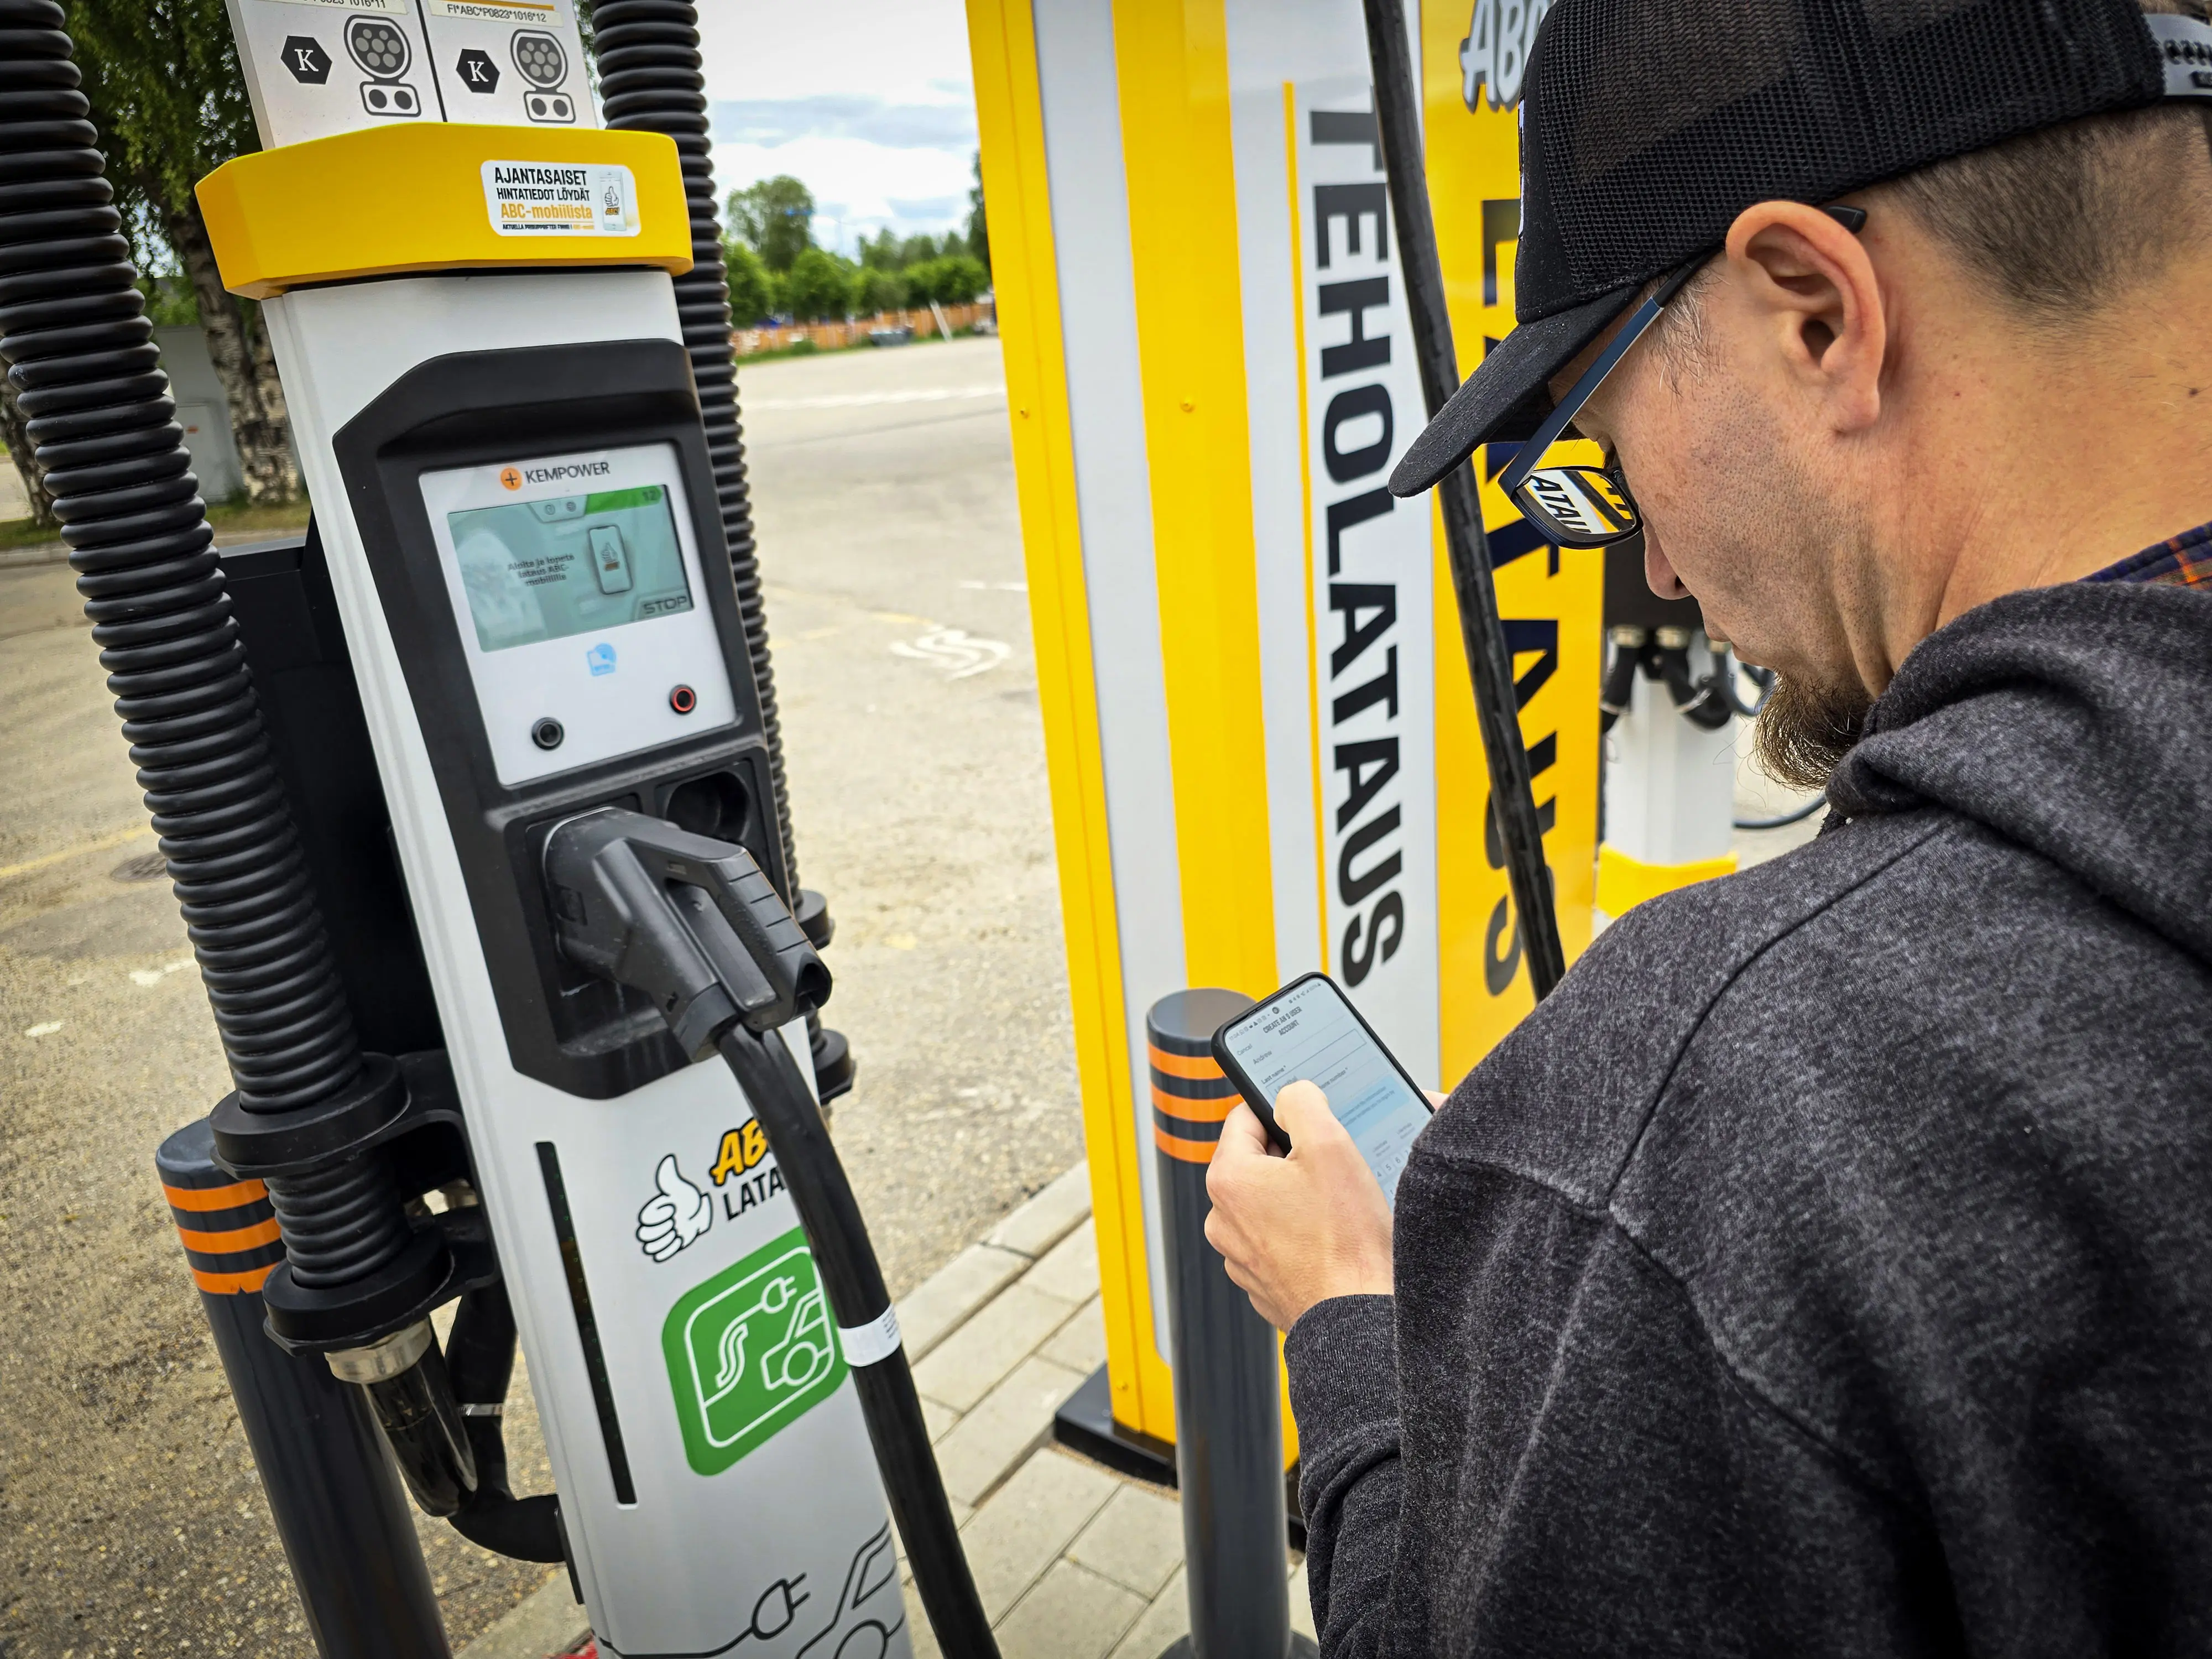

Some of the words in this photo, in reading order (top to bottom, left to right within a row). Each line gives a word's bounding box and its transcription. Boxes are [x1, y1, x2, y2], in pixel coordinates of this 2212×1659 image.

[294, 49, 319, 71] K
[467, 61, 489, 82] K
[495, 167, 587, 186] AJANTASAISET
[497, 187, 554, 201] HINTATIEDOT
[557, 187, 590, 201] LÖYDÄT
[501, 203, 593, 219] ABC-mobiilista
[525, 462, 611, 484] KEMPOWER
[1309, 85, 1404, 987] TEHOLATAUS
[643, 596, 687, 614] STOP
[1263, 1020, 1279, 1032] CREATE
[1278, 1020, 1298, 1035] ACCOUNT
[1253, 1050, 1272, 1064] Andrew
[709, 1117, 772, 1187] AB
